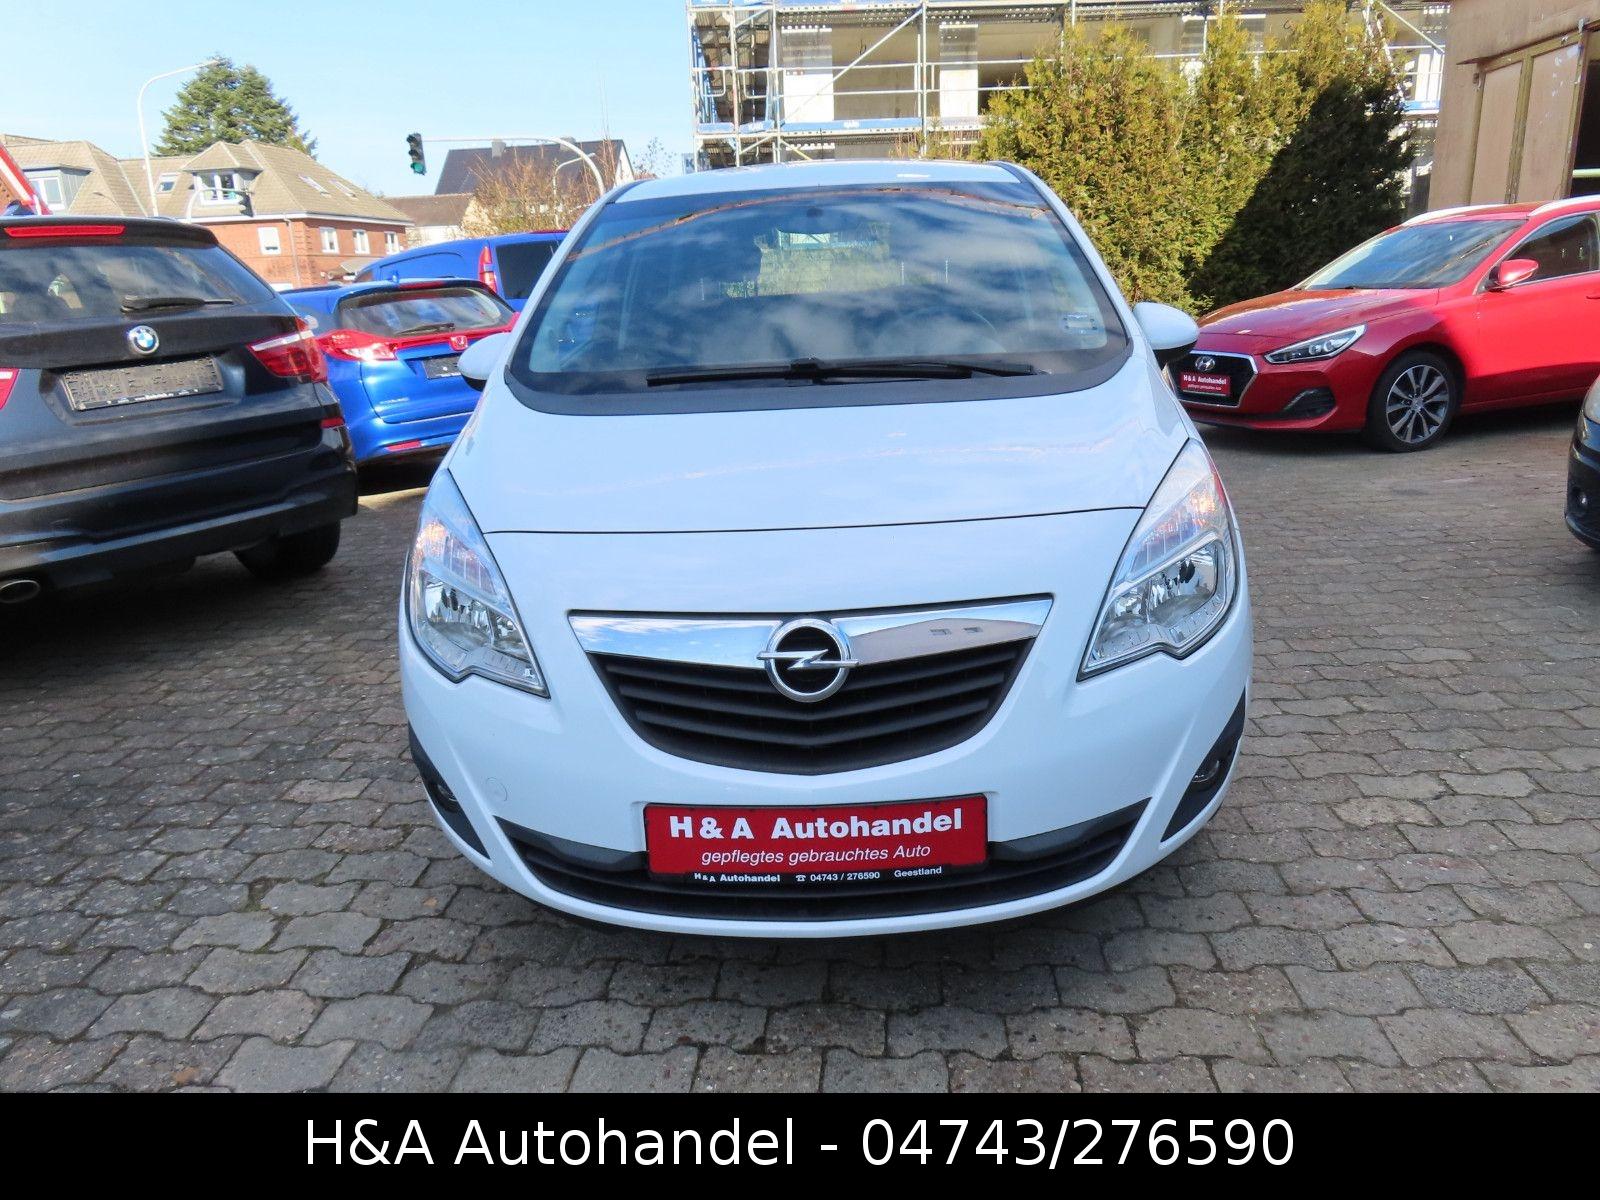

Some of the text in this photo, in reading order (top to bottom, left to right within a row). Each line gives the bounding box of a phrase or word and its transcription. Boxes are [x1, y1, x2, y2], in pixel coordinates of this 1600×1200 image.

[771, 808, 962, 839] Autohandel
[701, 844, 931, 866] gepflegtes gebrauchtes Auto
[720, 874, 781, 883] Autohandel
[810, 872, 839, 882] 04743
[847, 871, 881, 881] 276590
[894, 866, 943, 879] Geestland
